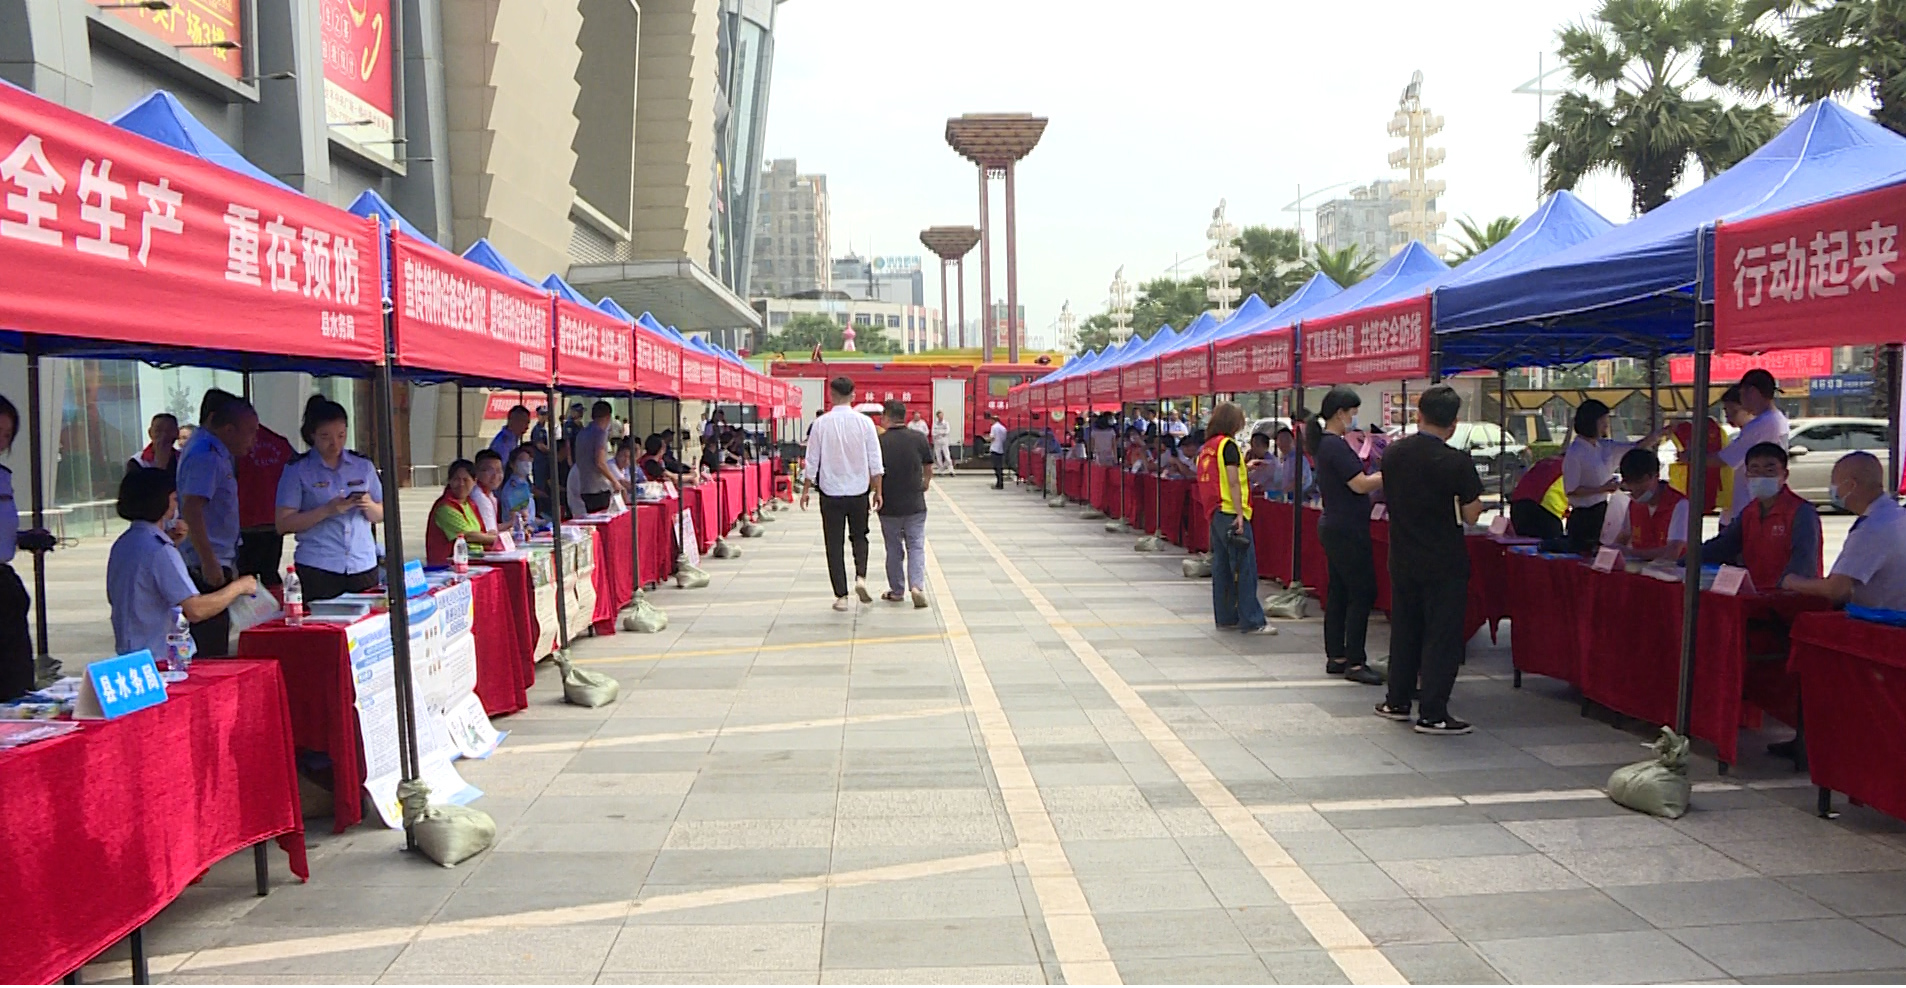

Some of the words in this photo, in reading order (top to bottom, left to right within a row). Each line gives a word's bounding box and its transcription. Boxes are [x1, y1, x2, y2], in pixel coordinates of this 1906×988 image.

[0, 134, 184, 267] 全生产
[223, 203, 360, 306] 重在预防
[1733, 221, 1899, 310] 行动起来
[321, 311, 356, 341] 县水务局
[100, 663, 160, 704] 县水务局
